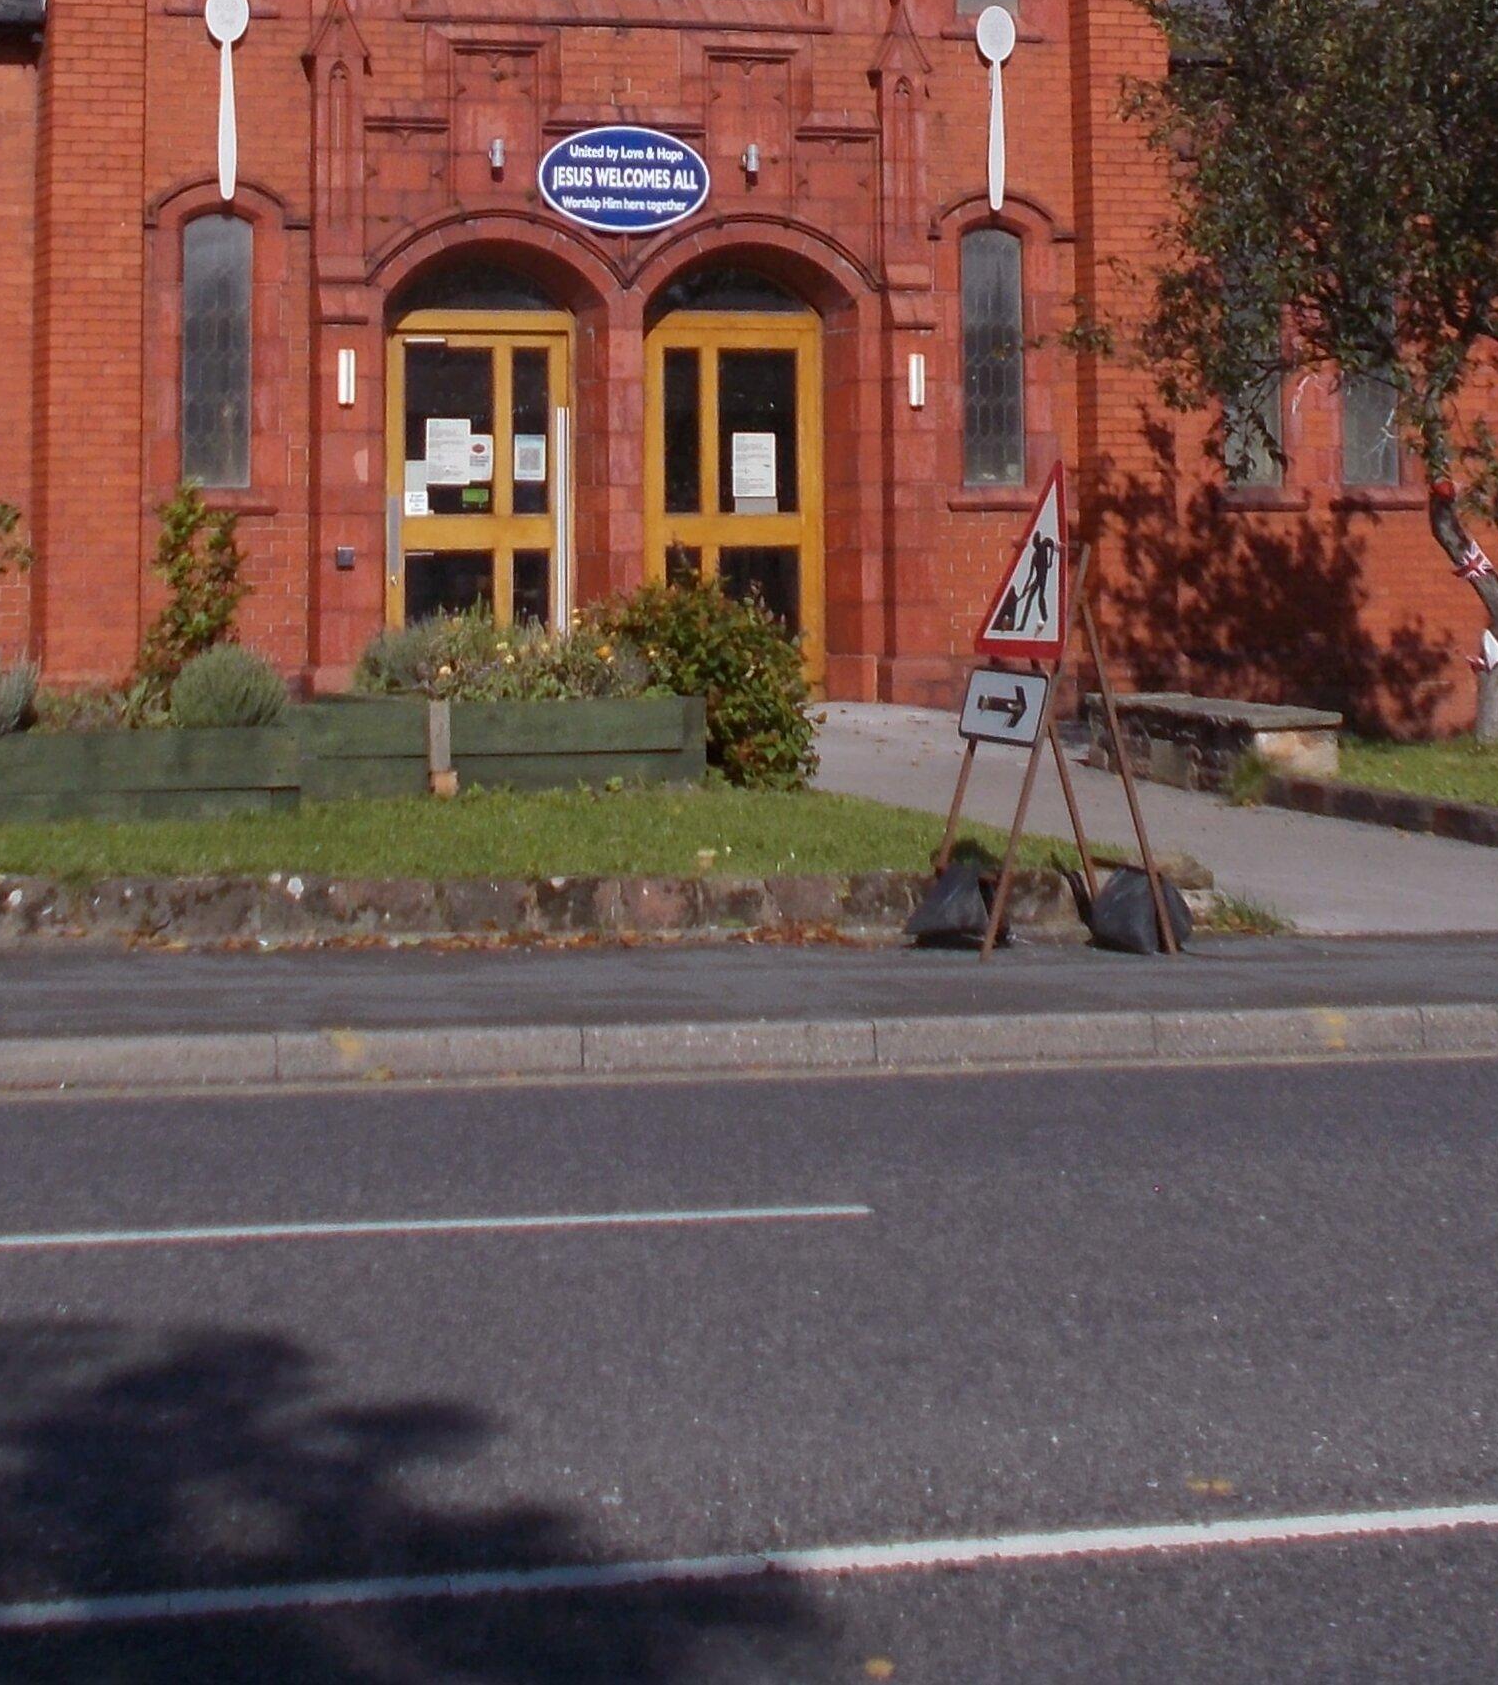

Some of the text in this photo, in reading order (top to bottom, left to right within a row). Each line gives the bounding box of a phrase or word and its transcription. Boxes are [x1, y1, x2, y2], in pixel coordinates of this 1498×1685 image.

[569, 145, 684, 163] United by Love & Hope
[552, 166, 698, 190] JESUS WELCOMES ALL
[561, 196, 687, 215] Worship Him here together
